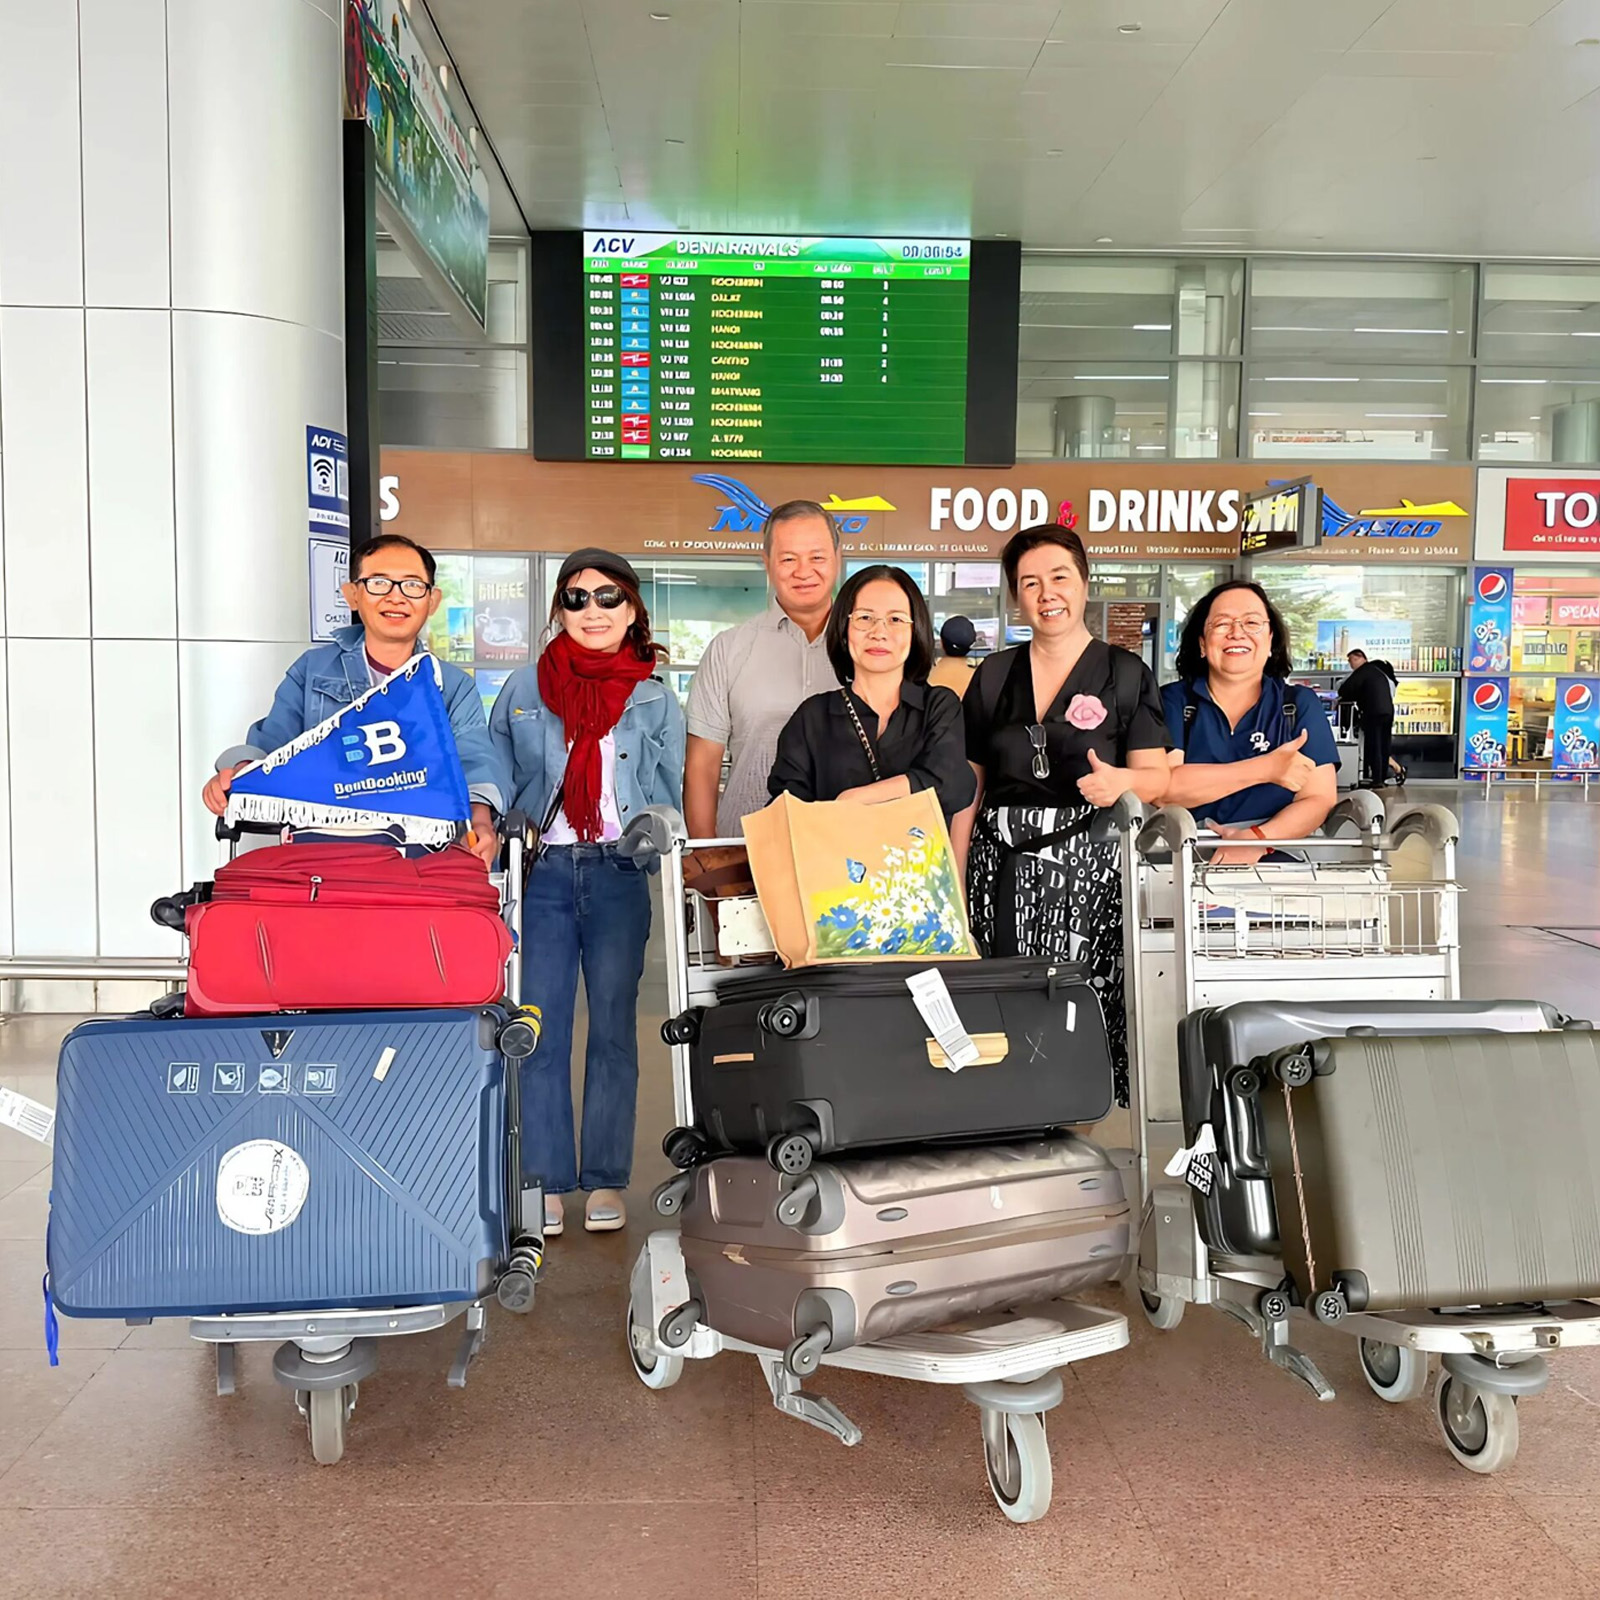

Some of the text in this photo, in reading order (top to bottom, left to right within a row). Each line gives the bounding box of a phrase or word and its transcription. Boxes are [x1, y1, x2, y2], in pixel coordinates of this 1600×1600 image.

[592, 237, 636, 253] ACV
[930, 488, 1048, 532] FOOD
[1089, 490, 1240, 533] DRINKS
